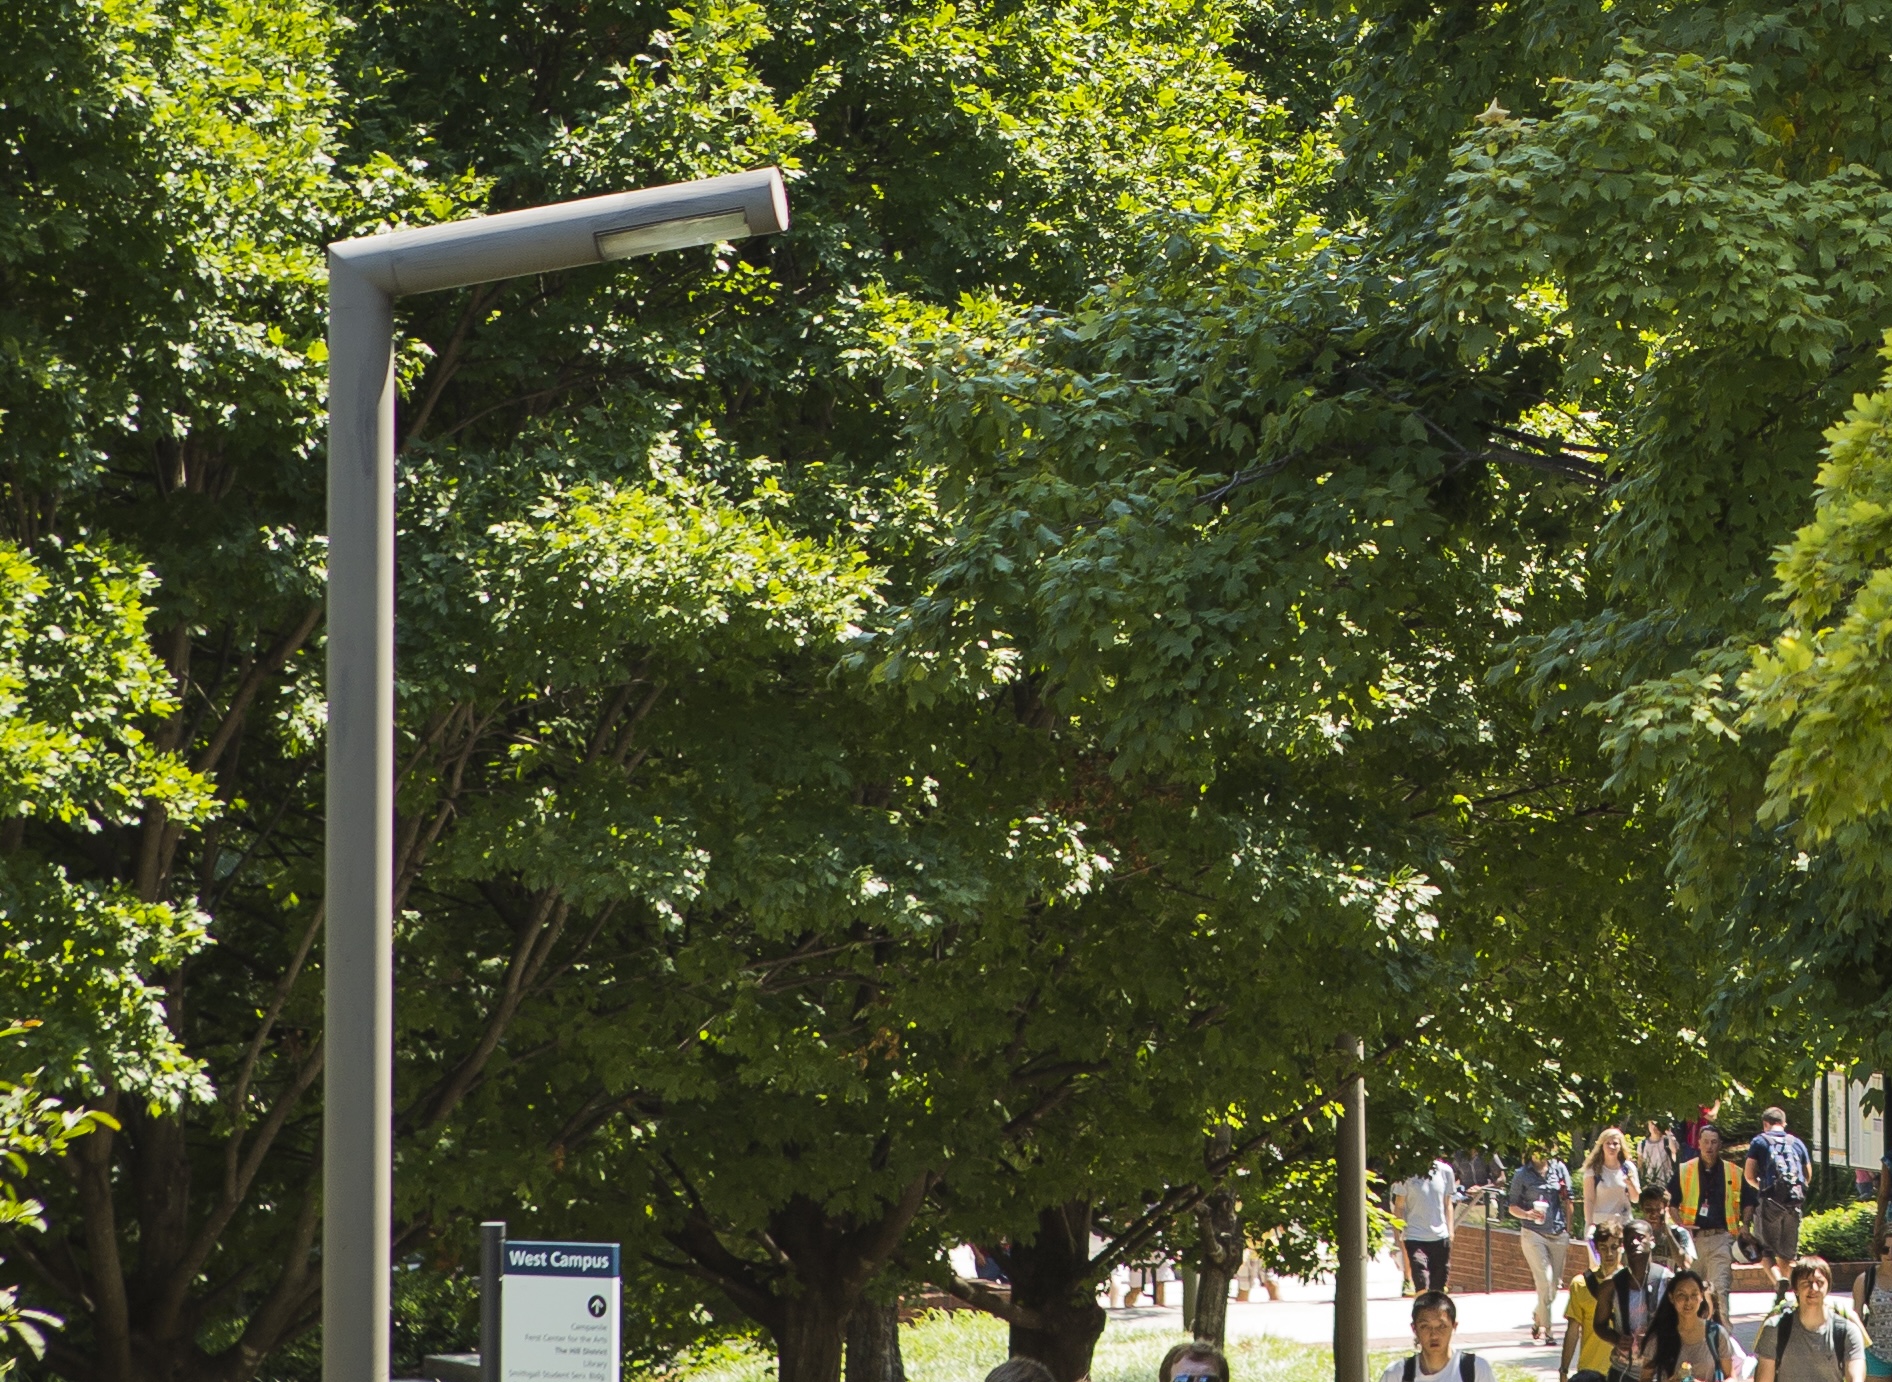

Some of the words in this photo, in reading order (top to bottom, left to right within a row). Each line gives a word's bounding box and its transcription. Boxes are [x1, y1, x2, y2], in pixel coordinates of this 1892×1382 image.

[509, 1250, 547, 1267] West
[550, 1251, 609, 1272] Campus
[580, 1335, 591, 1343] the
[555, 1346, 567, 1354] The
[583, 1360, 607, 1370] Library
